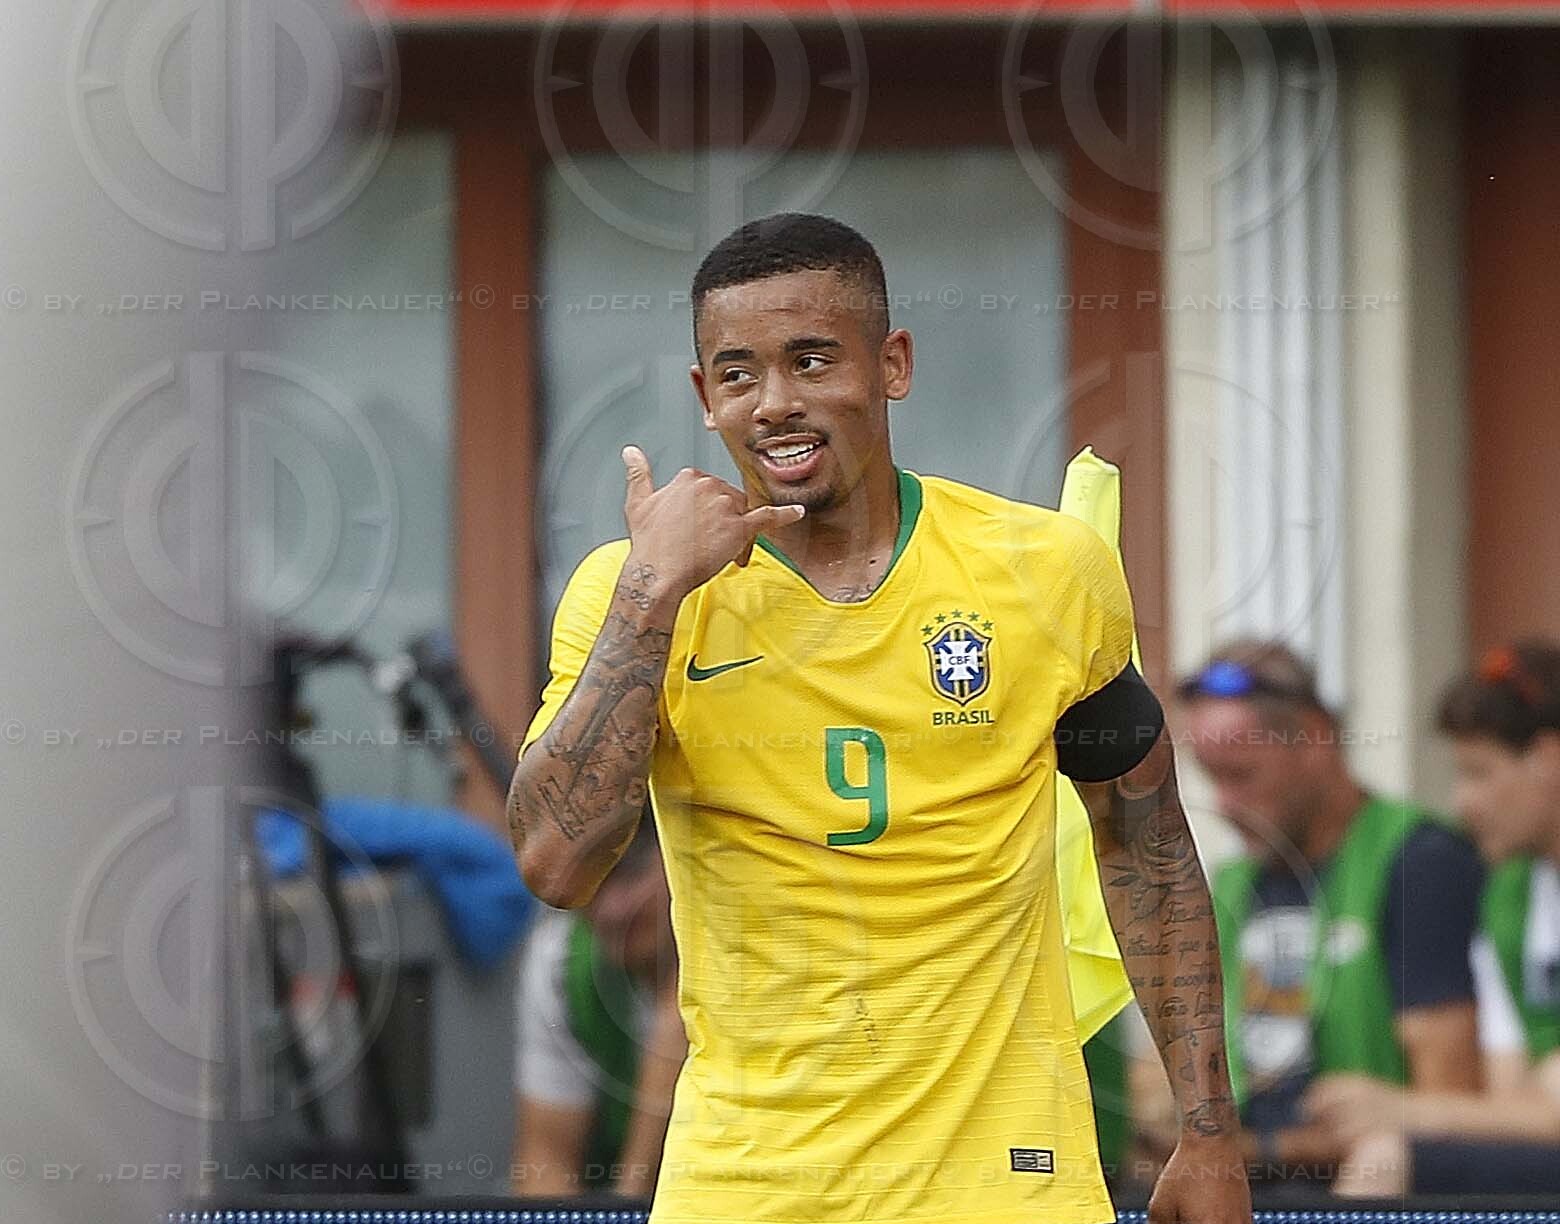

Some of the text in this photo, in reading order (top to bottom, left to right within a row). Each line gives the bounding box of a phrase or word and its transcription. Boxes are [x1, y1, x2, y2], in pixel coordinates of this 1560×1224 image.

[948, 655, 972, 667] CBF
[932, 710, 995, 727] BRASIL
[824, 727, 889, 847] 9
